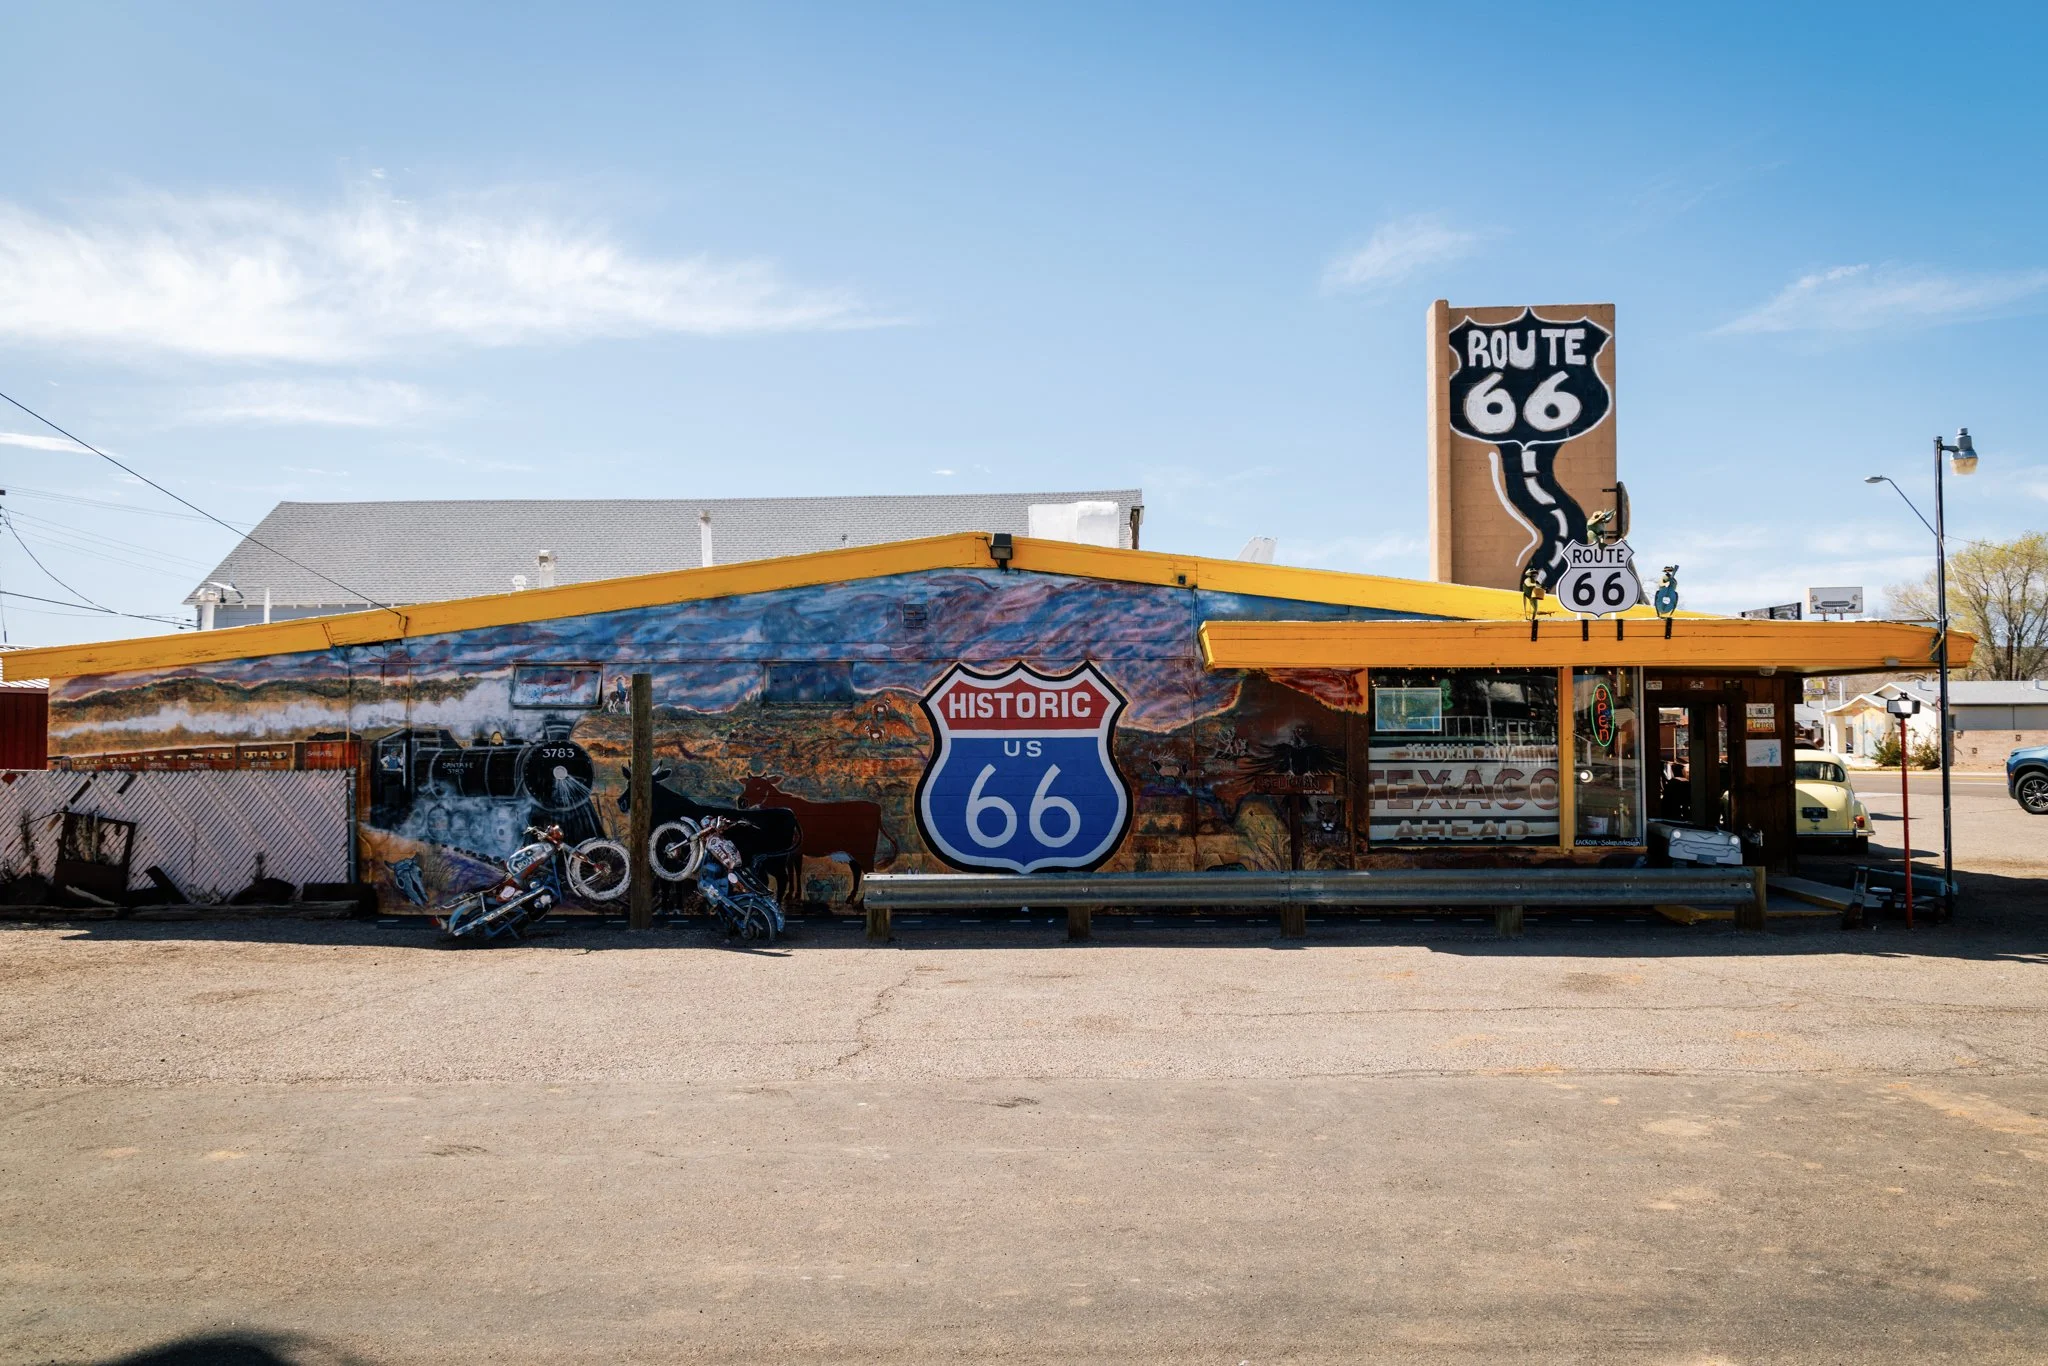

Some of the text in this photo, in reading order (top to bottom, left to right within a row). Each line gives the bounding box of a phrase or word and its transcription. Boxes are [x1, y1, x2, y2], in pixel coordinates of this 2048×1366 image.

[1468, 328, 1587, 370] ROUTE
[1463, 370, 1582, 434] 66
[1572, 548, 1625, 564] ROUTE
[1572, 571, 1626, 607] 66
[949, 691, 1092, 719] HISTORIC
[542, 748, 575, 758] 3783
[1003, 740, 1042, 757] US
[1368, 768, 1560, 810] TEXACO
[965, 763, 1081, 848] 66
[1393, 819, 1530, 841] AHEAD
